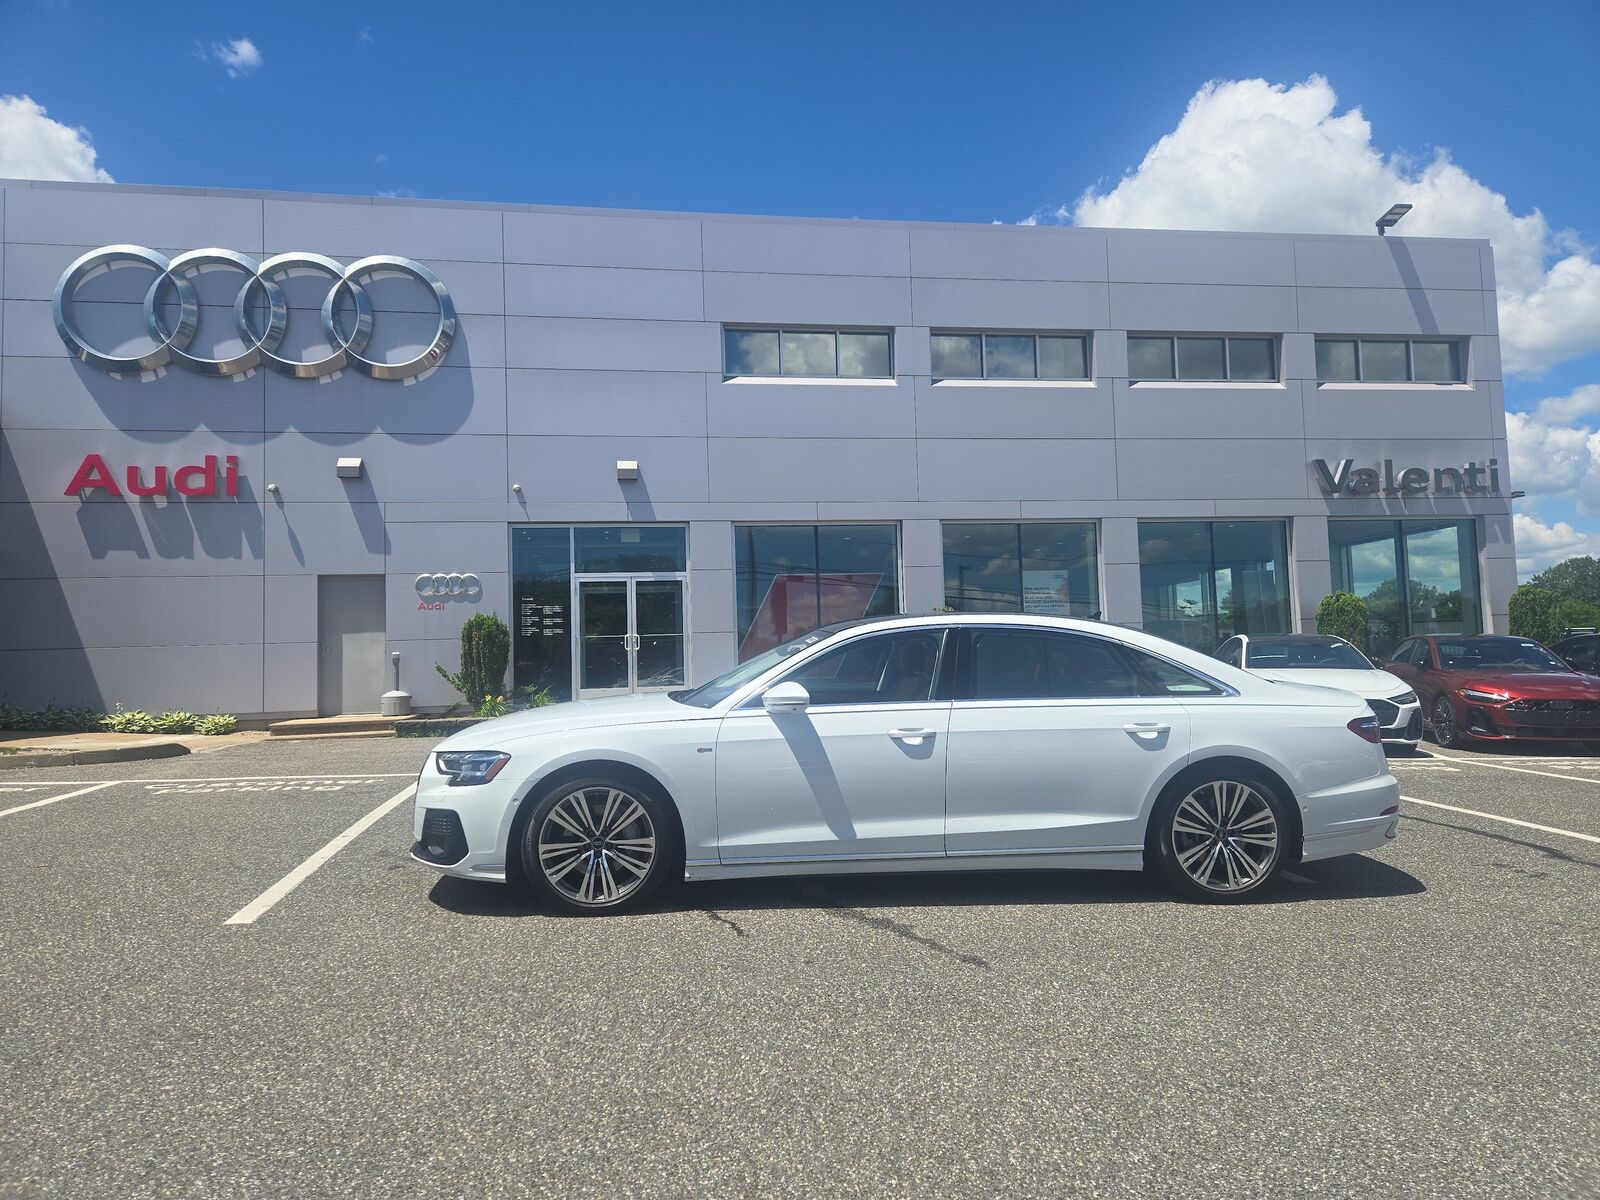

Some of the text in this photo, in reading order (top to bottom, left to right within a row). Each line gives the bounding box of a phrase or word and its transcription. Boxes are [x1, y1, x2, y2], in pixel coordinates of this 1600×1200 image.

[64, 454, 239, 497] Audi
[1312, 458, 1500, 494] Valenti
[417, 600, 445, 611] Audi
